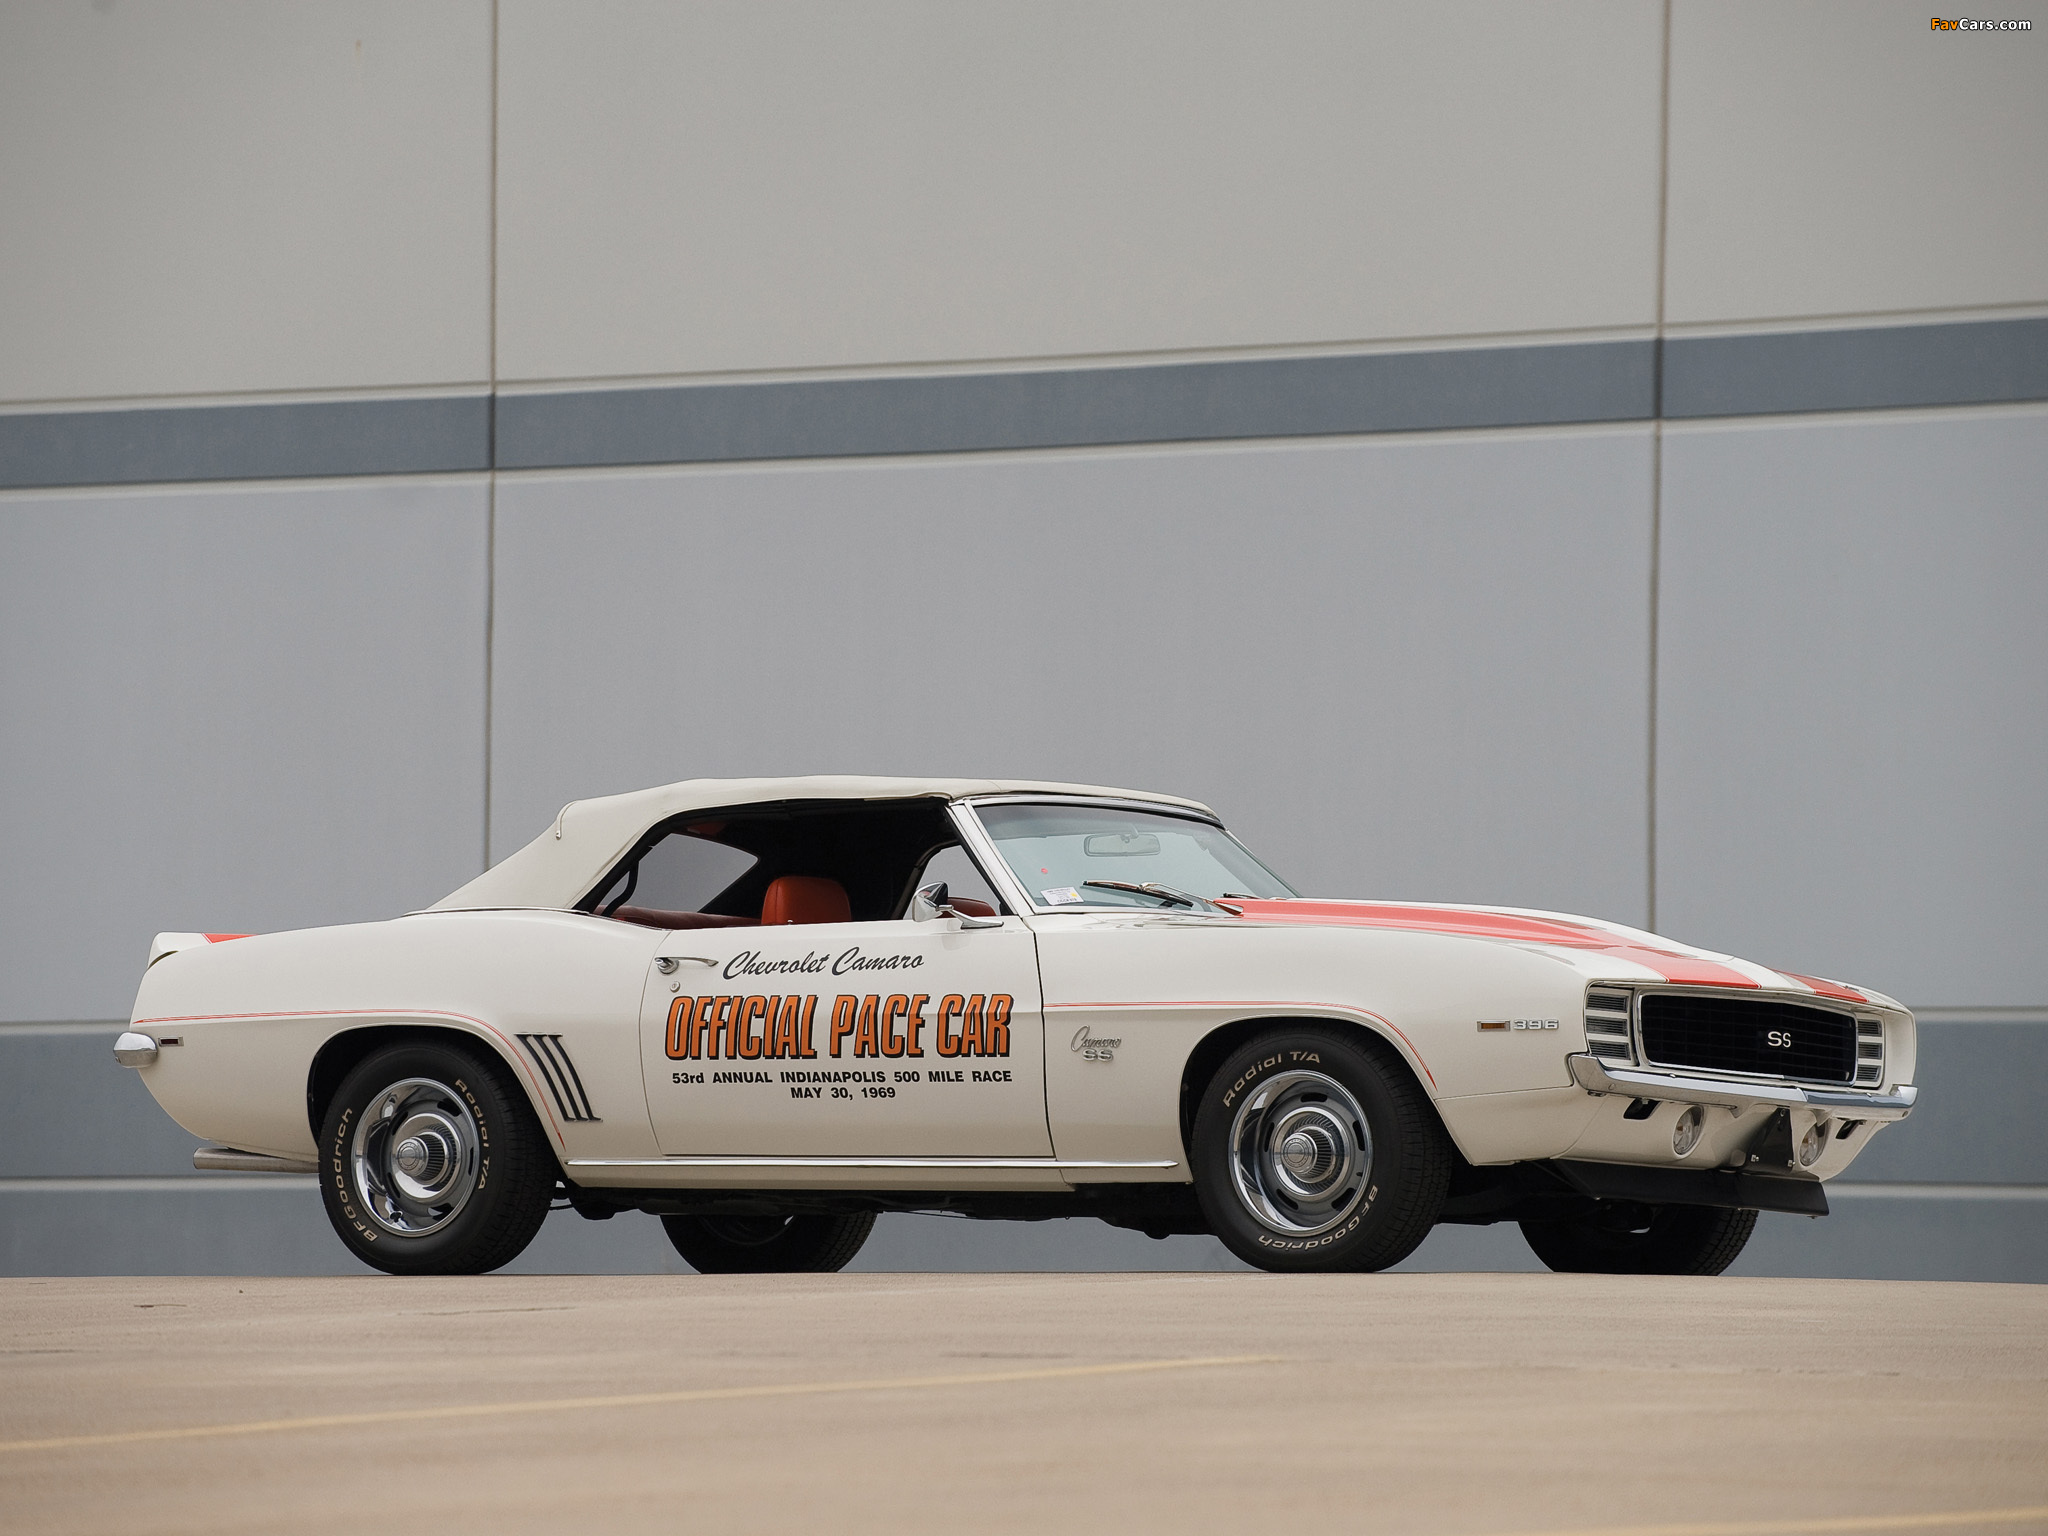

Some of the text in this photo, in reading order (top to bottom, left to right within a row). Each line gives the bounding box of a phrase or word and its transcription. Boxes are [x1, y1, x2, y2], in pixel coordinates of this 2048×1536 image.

[722, 946, 924, 980] Chevrolet Camaro
[665, 994, 1015, 1060] OFFICIAL PACE CAR
[1513, 1019, 1559, 1031] 396
[1767, 1031, 1791, 1048] SS
[1082, 1048, 1114, 1062] SS
[672, 1070, 1012, 1084] 53rd ANNUAL INDIANAPOLIS 500 MILE RACE
[1222, 1051, 1321, 1108] Radial T/A
[790, 1087, 896, 1101] MAY 30, 1969
[455, 1079, 490, 1190] Radial T/A
